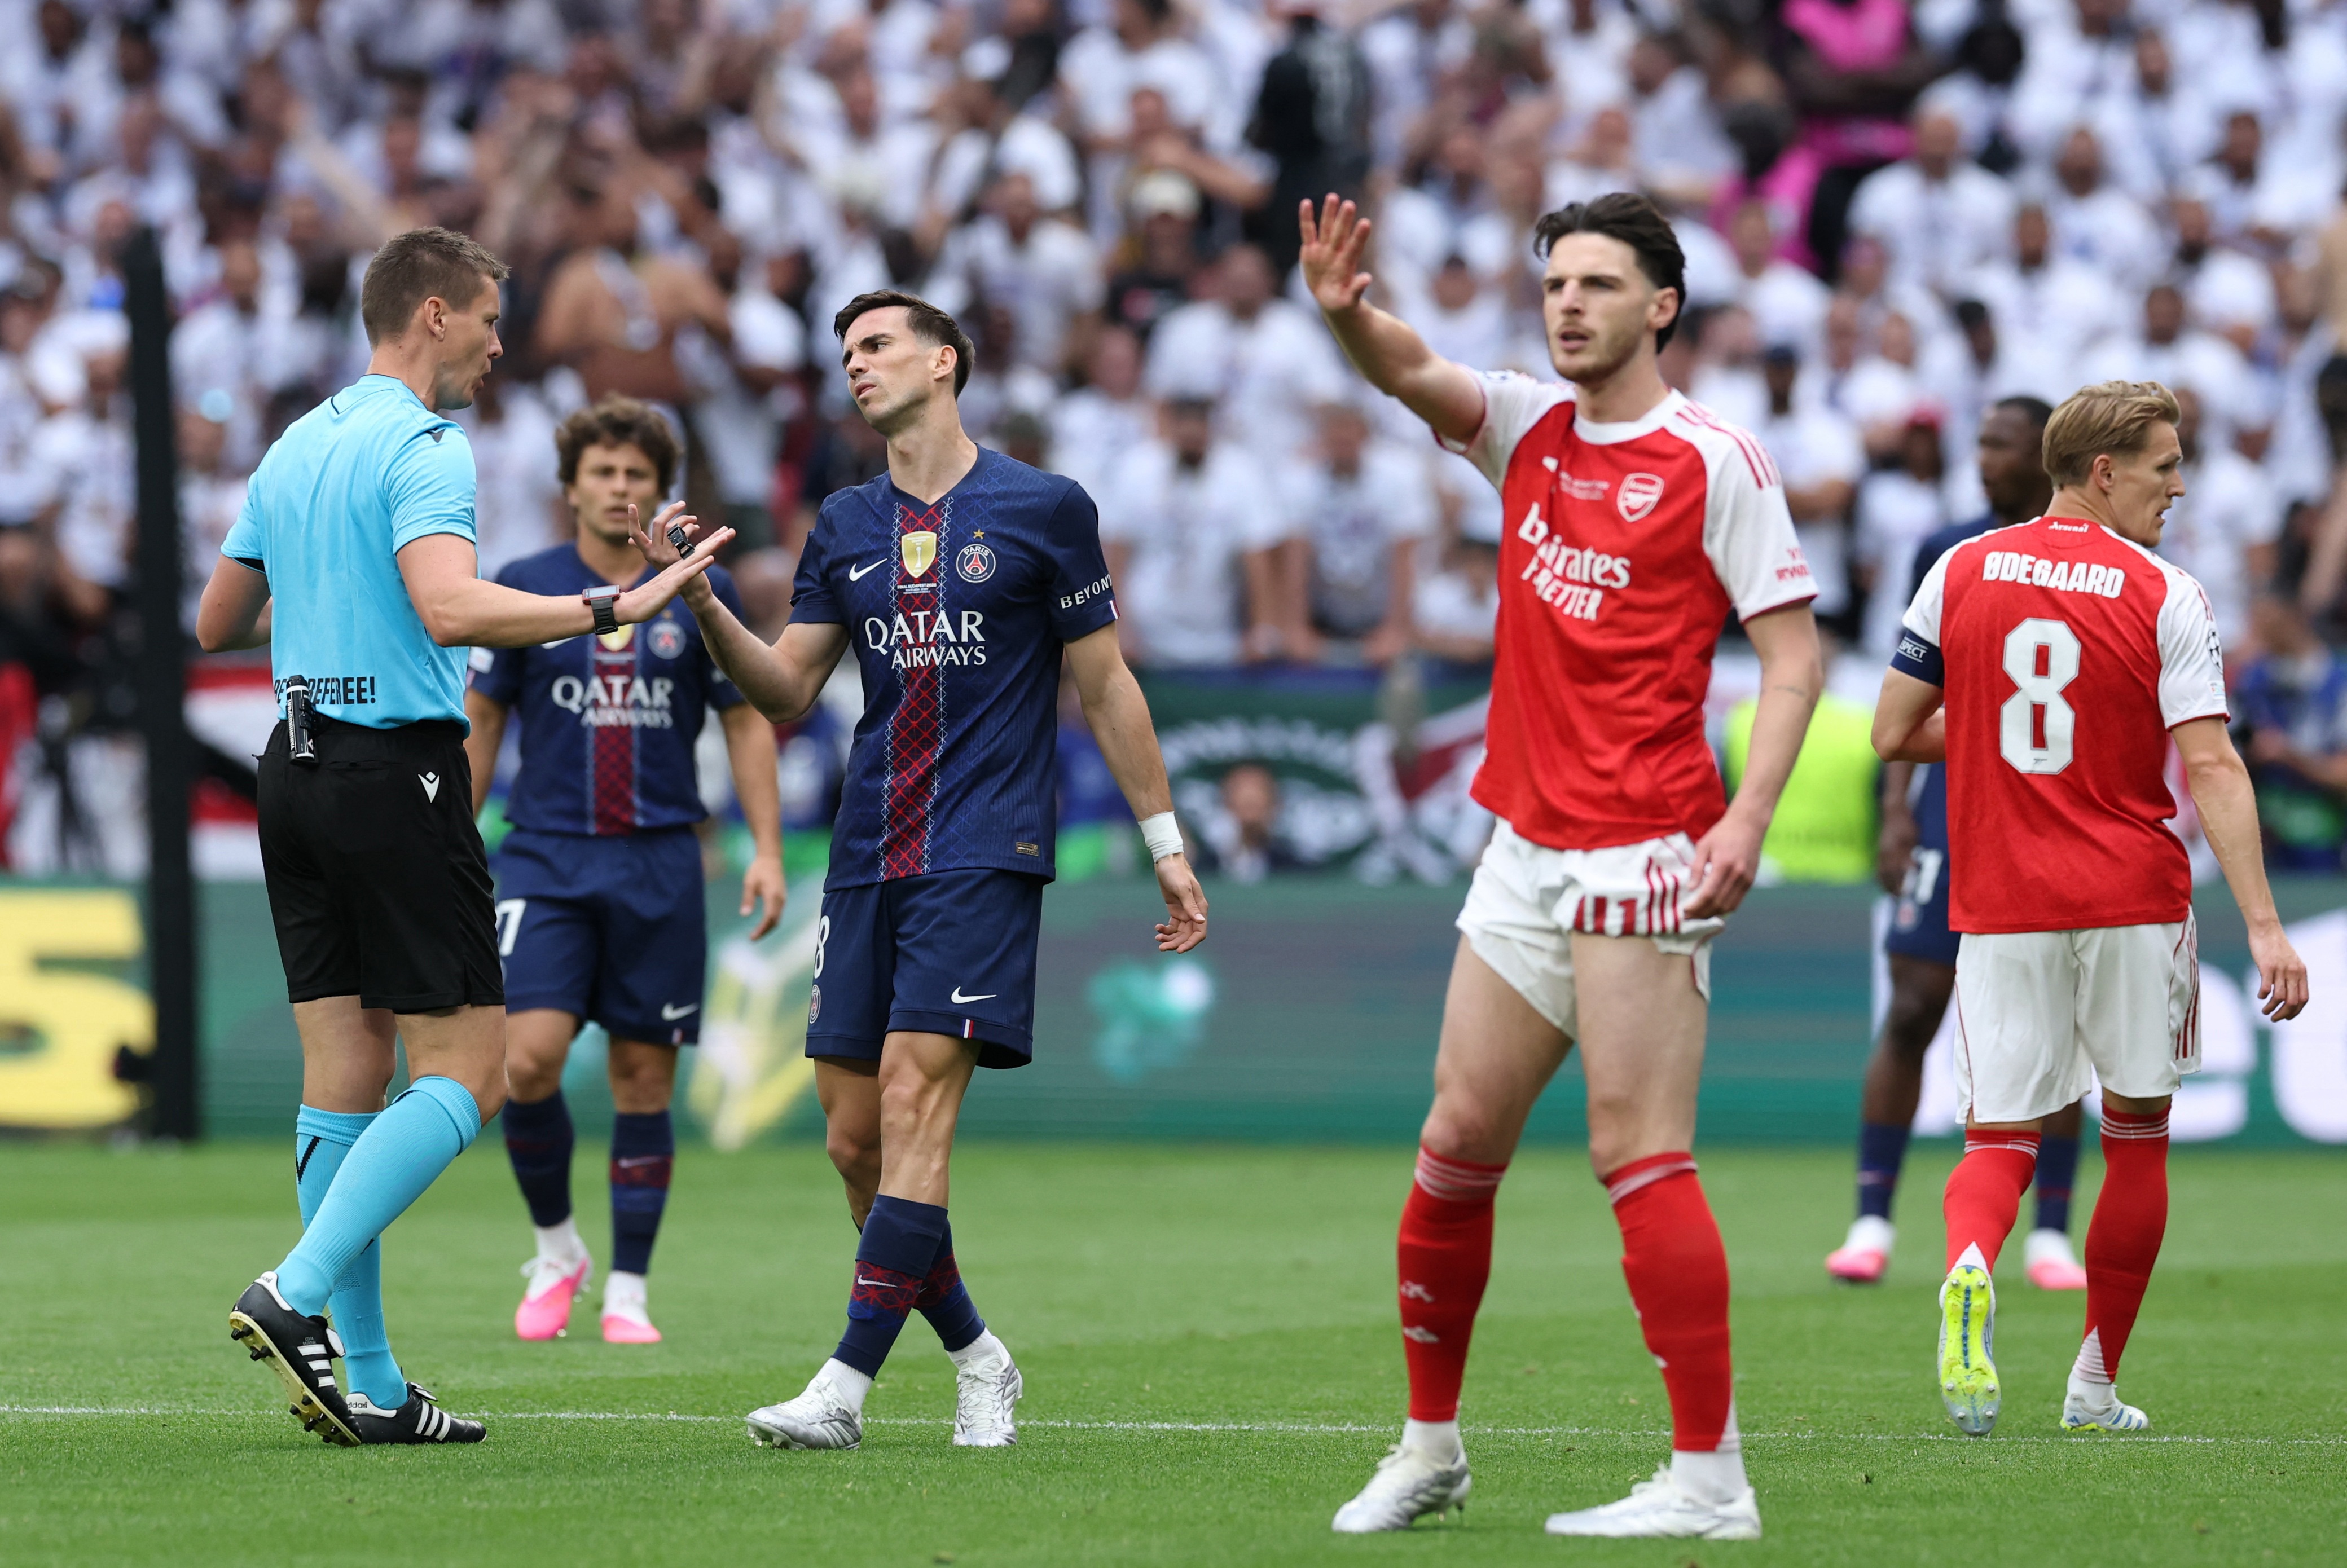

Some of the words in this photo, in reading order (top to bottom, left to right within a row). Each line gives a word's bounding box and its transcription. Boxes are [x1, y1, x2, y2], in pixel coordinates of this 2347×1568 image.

[964, 546, 990, 556] PARIS
[1983, 552, 2125, 598] ØDEGAARD
[865, 610, 986, 655] QATAR
[891, 646, 986, 670] AIRWAYS
[552, 676, 674, 714] QATAR
[2000, 618, 2081, 775] 8
